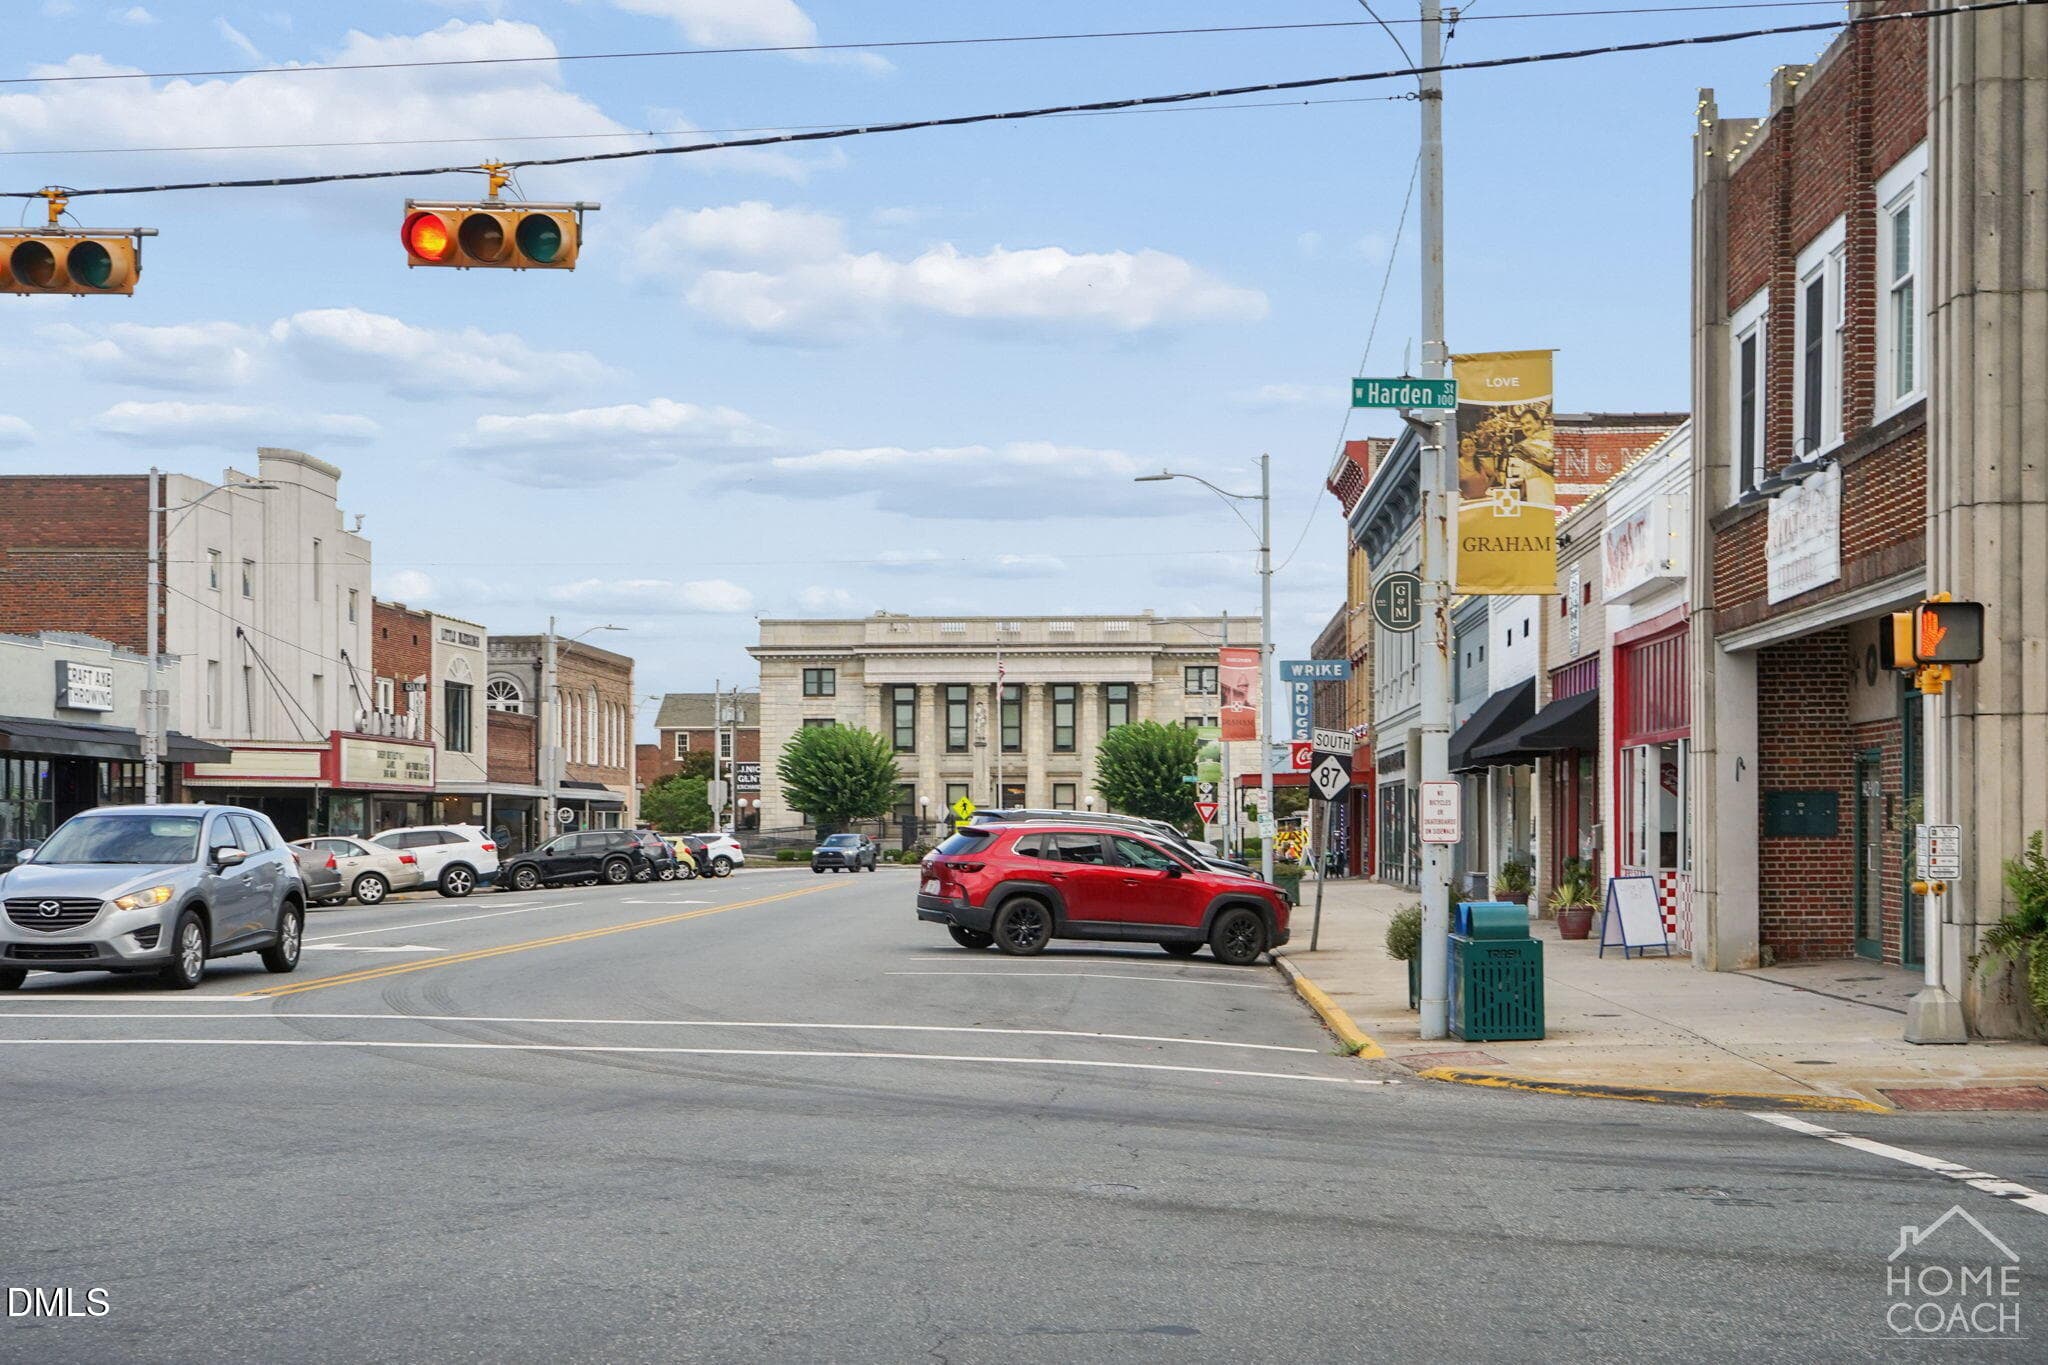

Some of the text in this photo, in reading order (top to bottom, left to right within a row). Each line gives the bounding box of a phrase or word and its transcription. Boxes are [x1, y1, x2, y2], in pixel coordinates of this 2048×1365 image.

[1486, 377, 1520, 387] LOVE
[1355, 382, 1455, 405] W Harden St
[1437, 394, 1455, 406] 100
[1554, 448, 1589, 477] N
[1463, 537, 1551, 552] GRAHAM
[1395, 585, 1406, 596] G
[1395, 607, 1407, 617] M
[1290, 664, 1342, 677] WRIKE
[1295, 682, 1309, 740] DRUGS
[1315, 733, 1350, 749] SOUTH
[1320, 766, 1341, 788] 87
